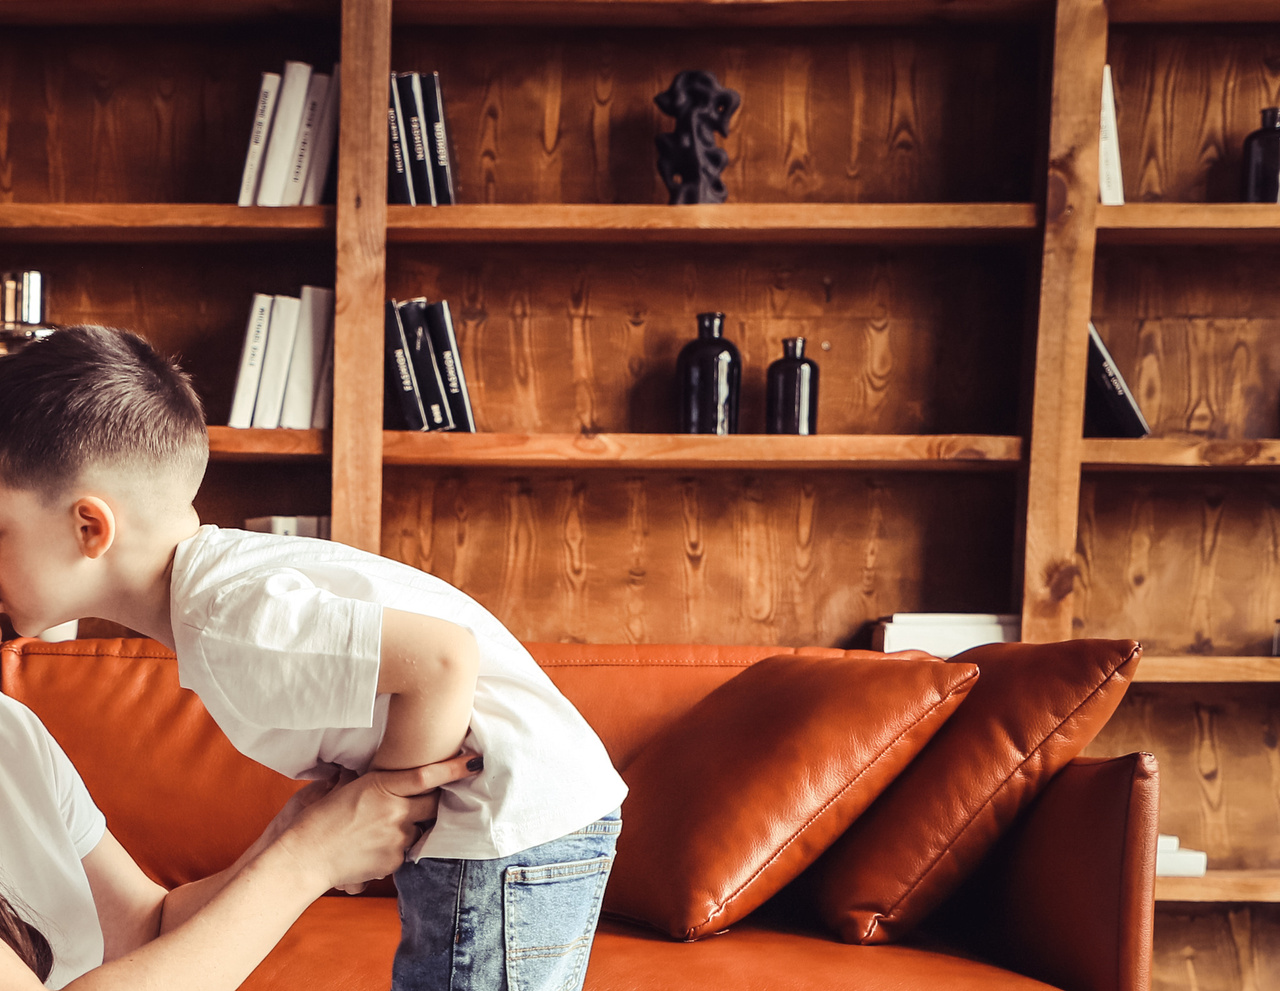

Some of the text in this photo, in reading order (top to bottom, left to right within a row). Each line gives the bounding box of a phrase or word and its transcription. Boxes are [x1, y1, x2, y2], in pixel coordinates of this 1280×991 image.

[410, 116, 424, 161] FASHION
[434, 121, 448, 166] FASHION
[394, 348, 413, 391] FASHION
[443, 350, 460, 394] FASHION
